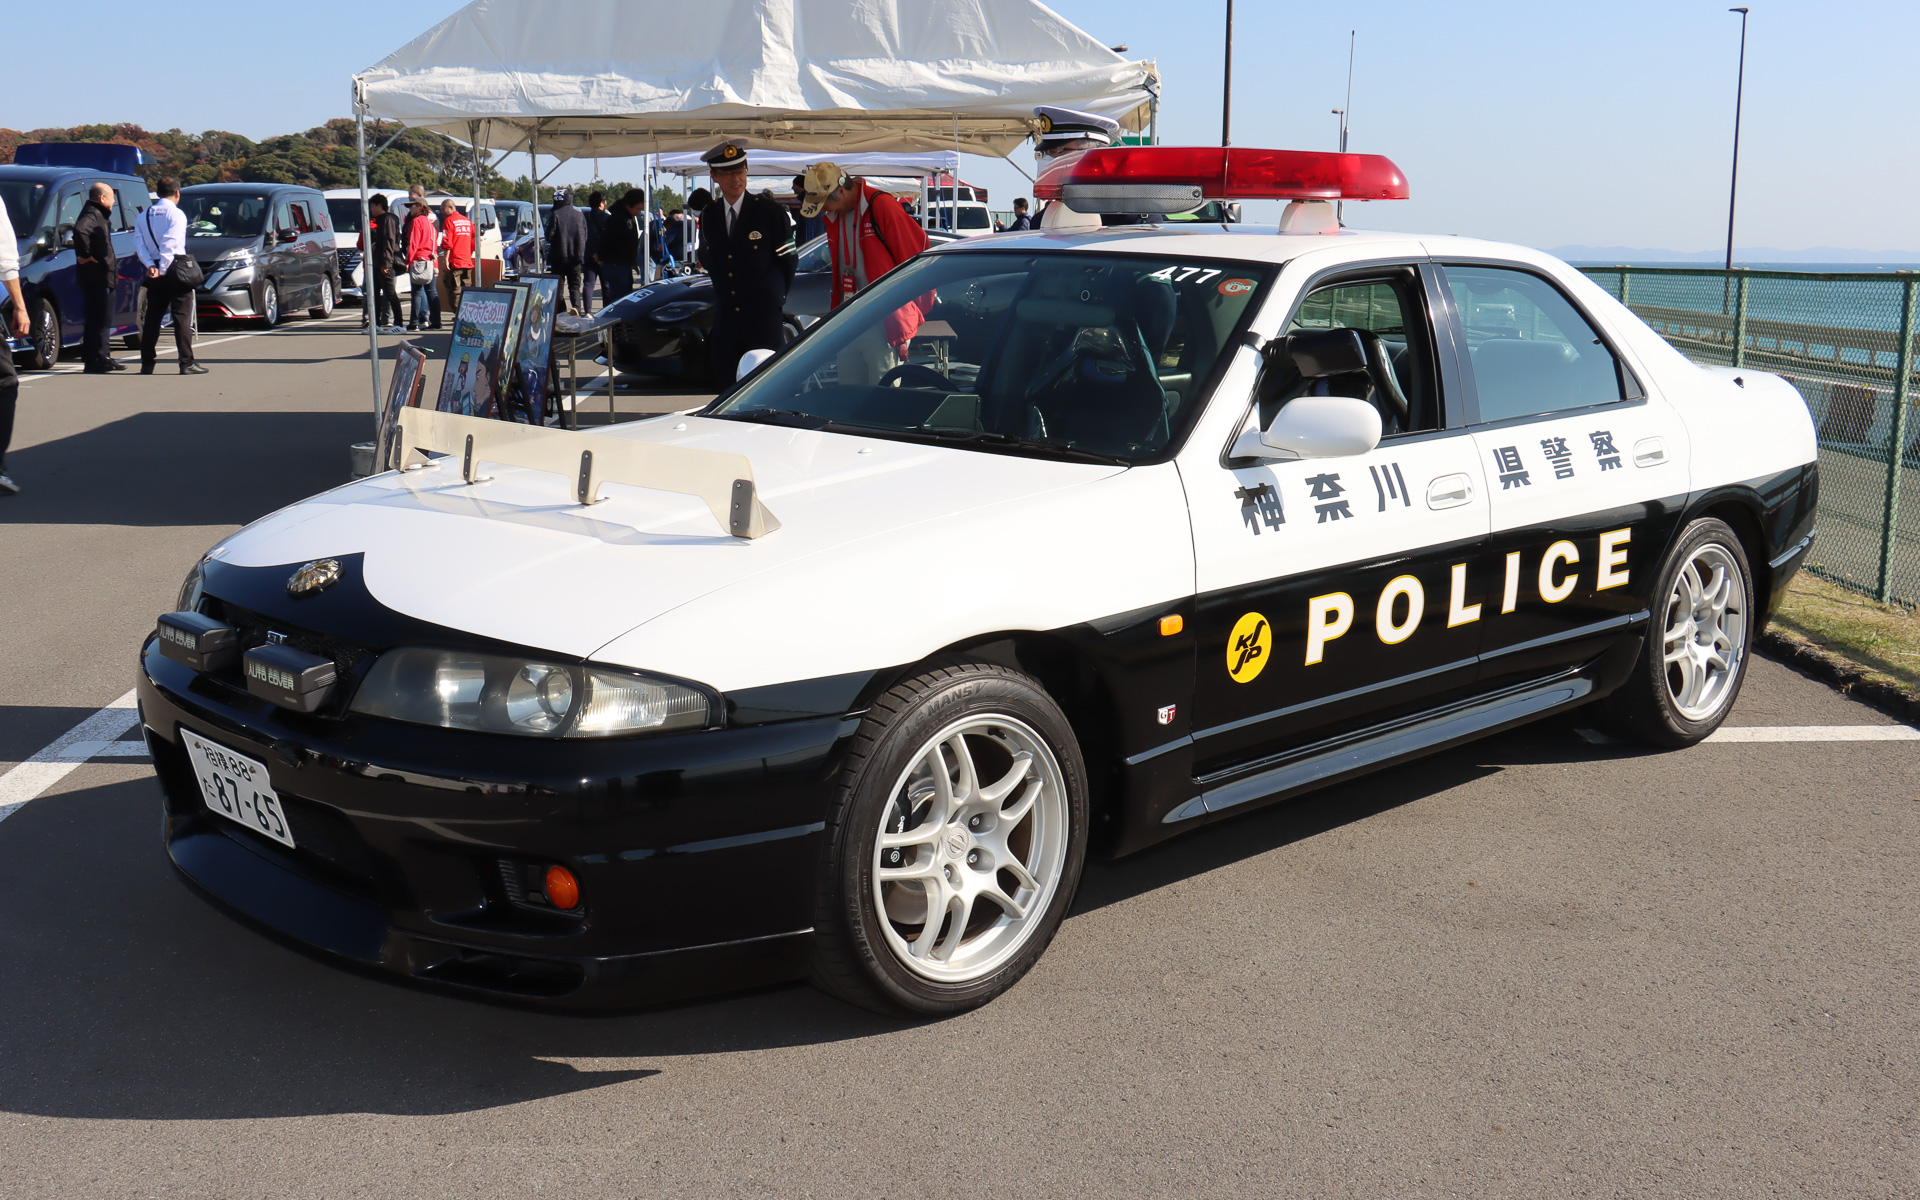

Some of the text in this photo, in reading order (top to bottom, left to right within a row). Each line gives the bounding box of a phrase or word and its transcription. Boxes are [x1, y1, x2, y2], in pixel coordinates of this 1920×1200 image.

[1150, 266, 1222, 284] 477
[1304, 527, 1631, 666] POLICE
[160, 624, 196, 651] AUTO COVER
[248, 660, 294, 691] AUTO COVER
[927, 685, 973, 716] MANS
[213, 772, 285, 838] 87-65
